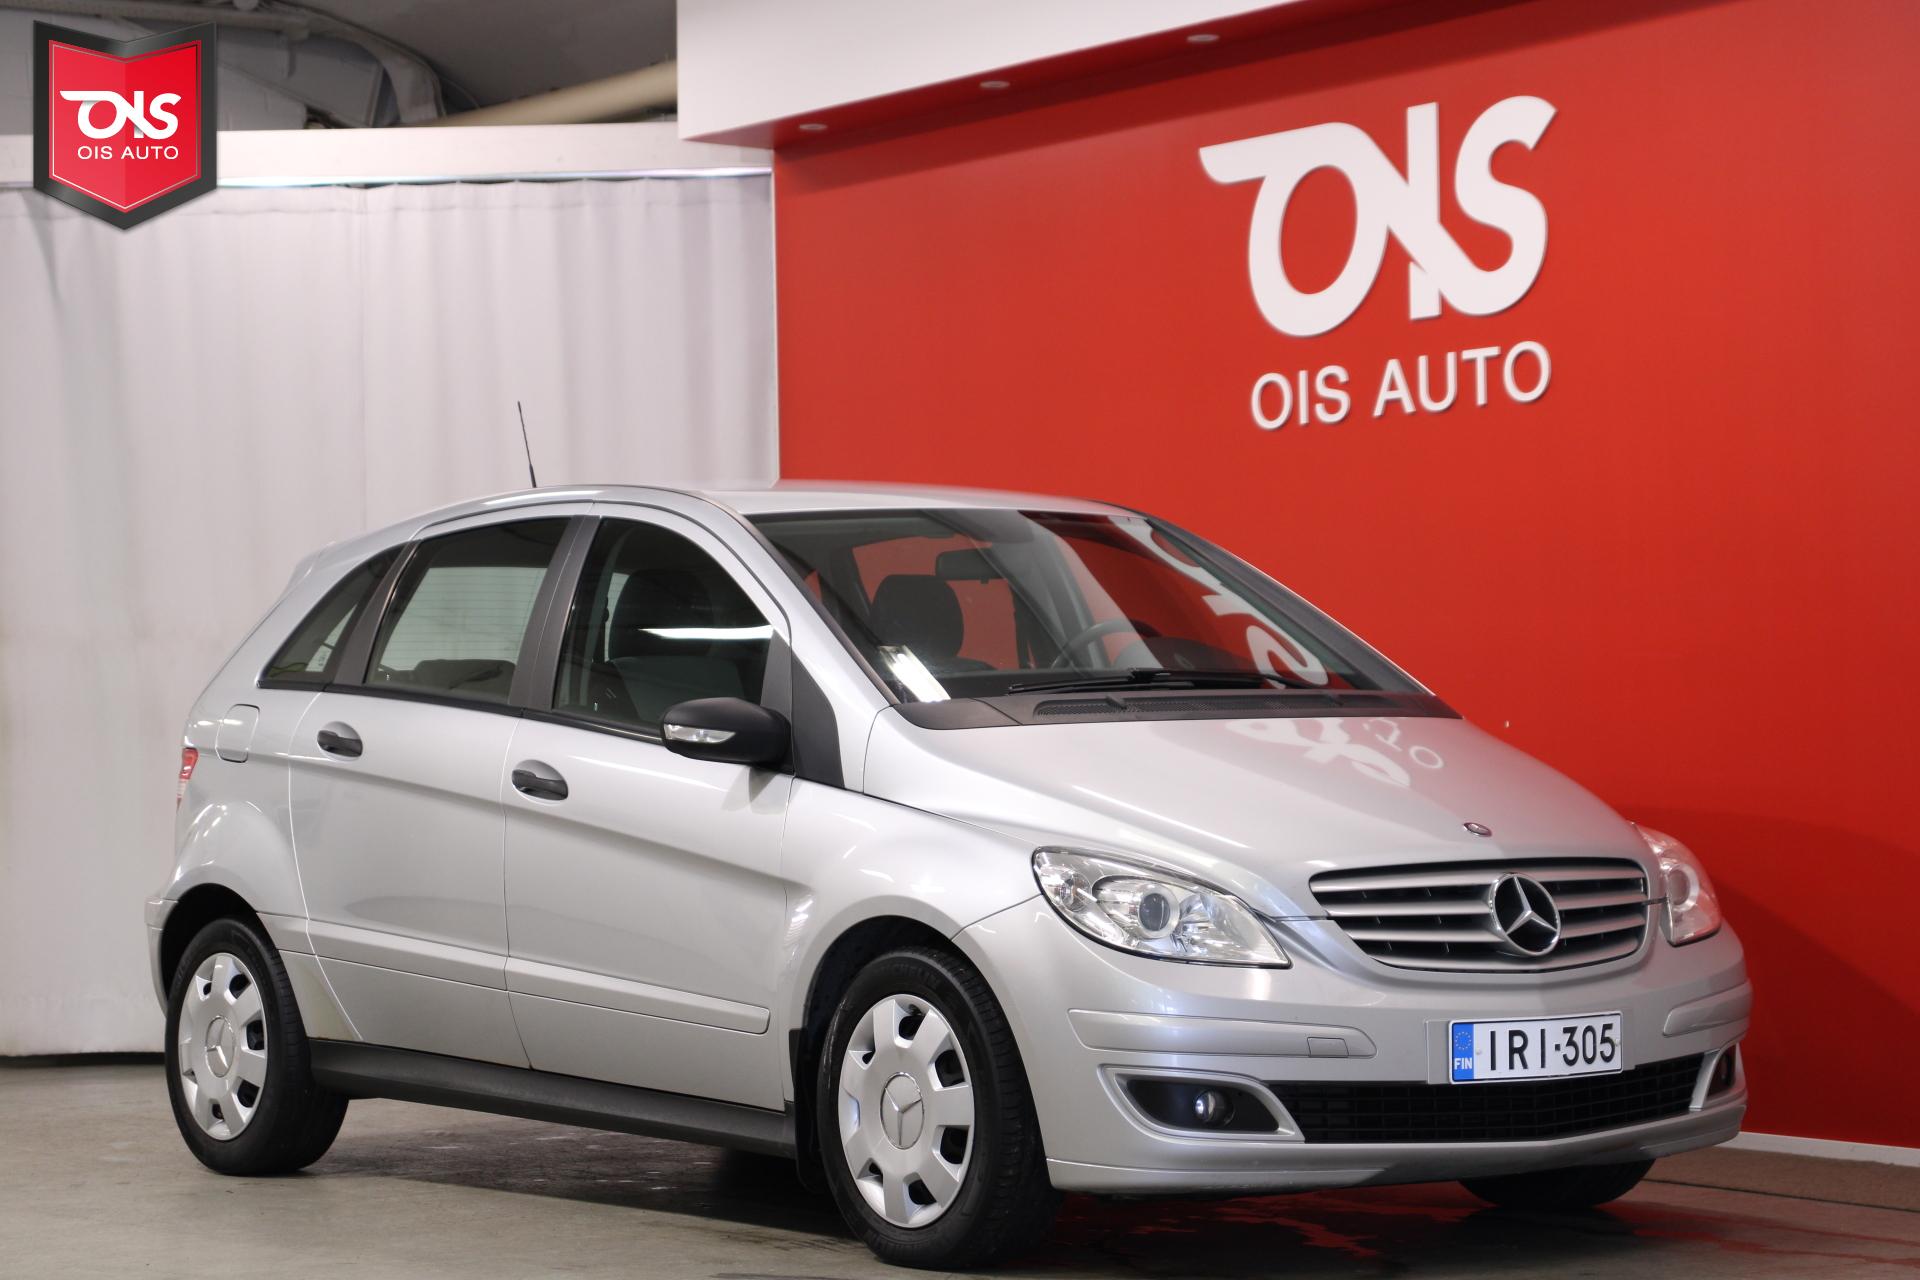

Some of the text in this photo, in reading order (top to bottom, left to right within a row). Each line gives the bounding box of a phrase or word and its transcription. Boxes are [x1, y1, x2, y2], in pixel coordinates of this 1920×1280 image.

[1199, 95, 1557, 336] OIS
[1251, 341, 1551, 430] OIS AUTO
[1454, 1057, 1473, 1070] FIN
